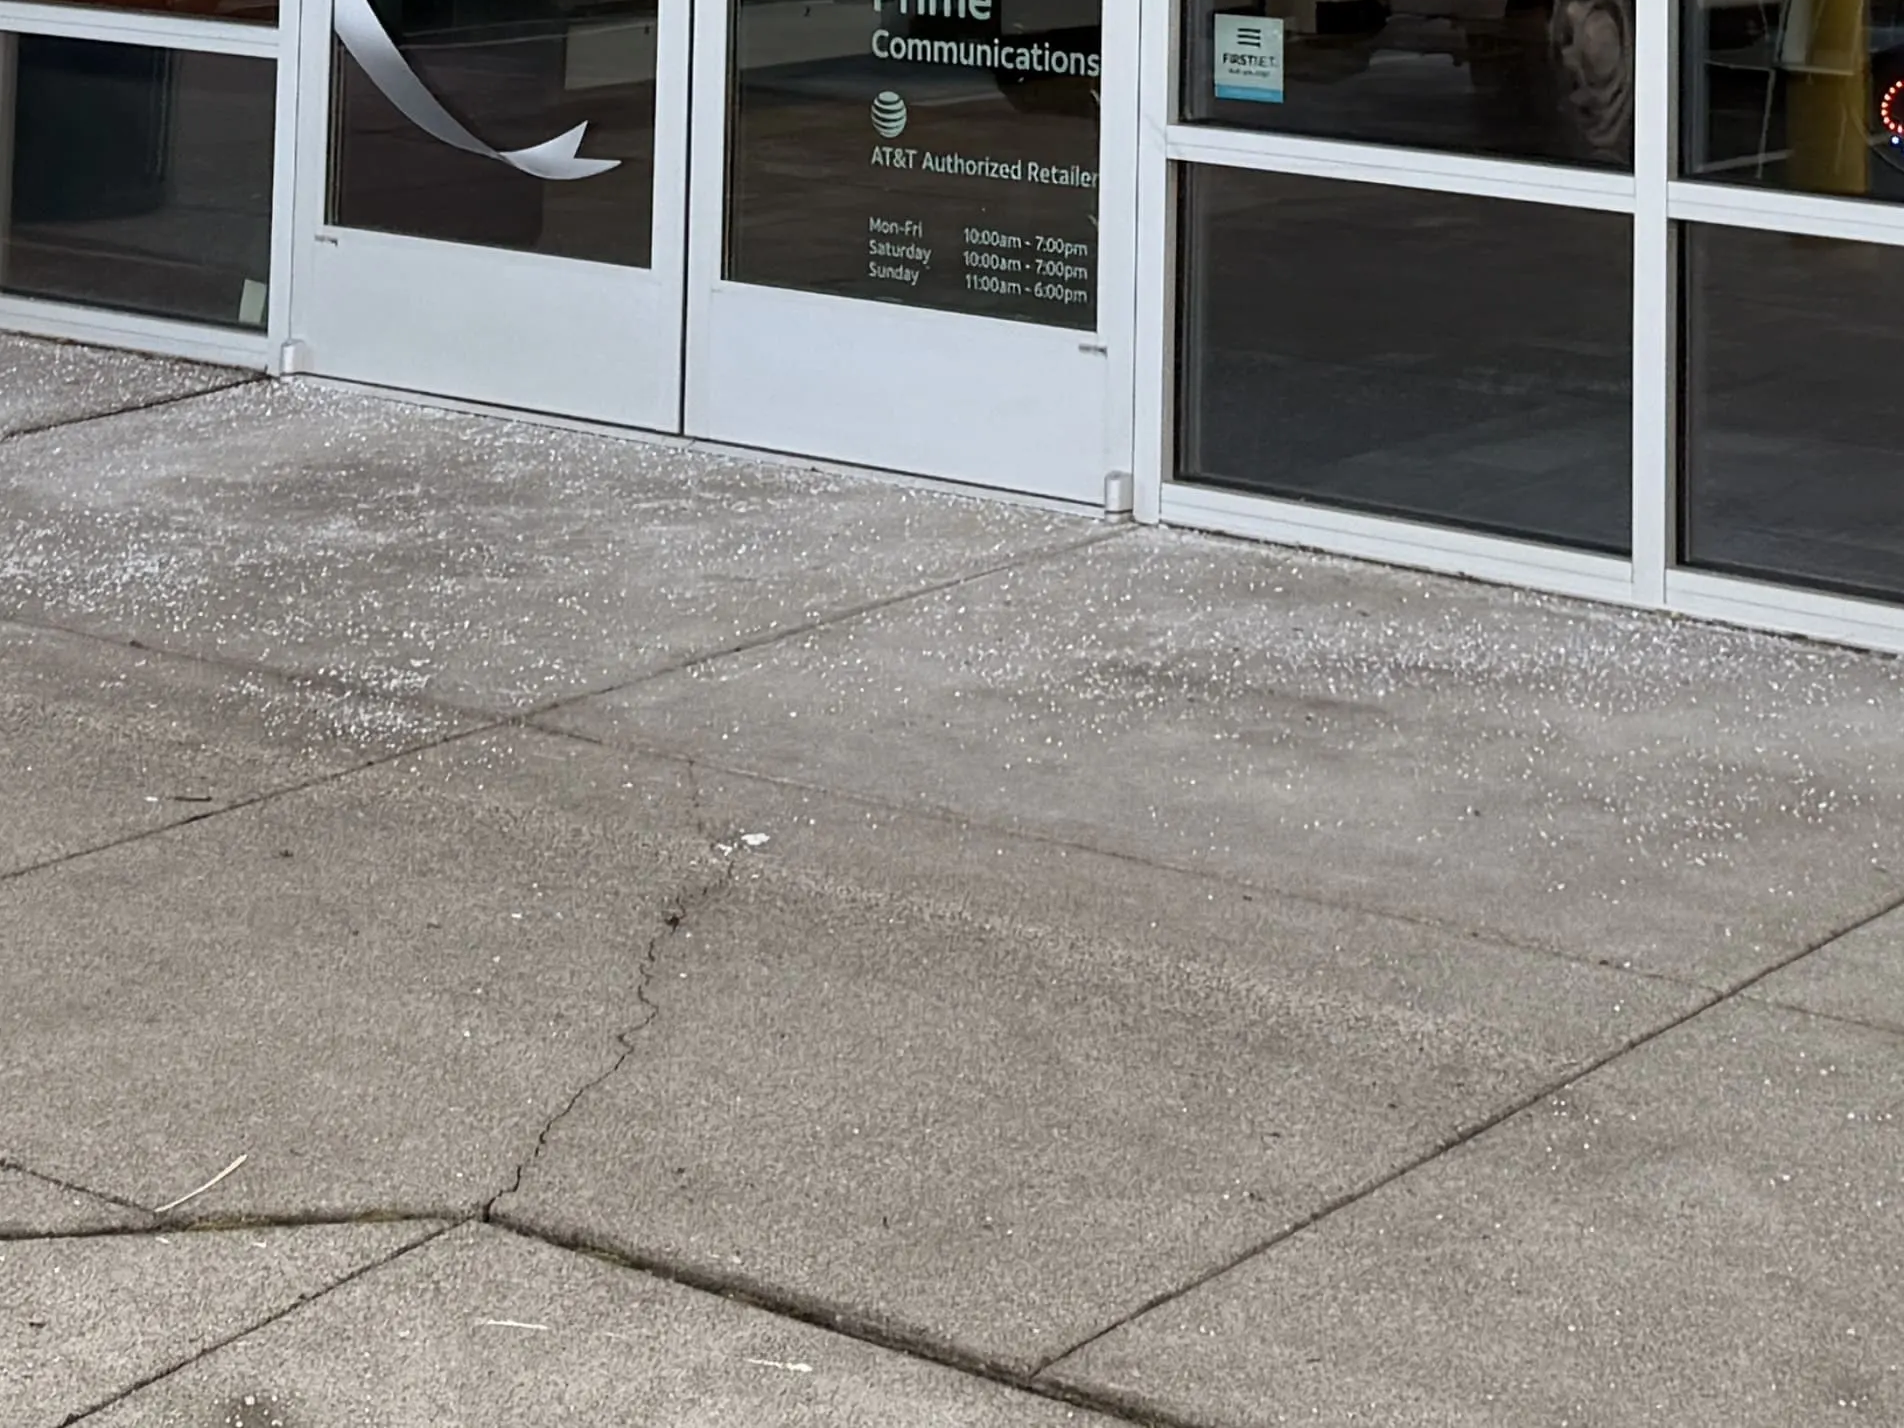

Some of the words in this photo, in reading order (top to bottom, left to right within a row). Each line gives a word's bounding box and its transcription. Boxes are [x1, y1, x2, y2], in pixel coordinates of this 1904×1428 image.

[871, 28, 1101, 78] Communications
[871, 146, 918, 169] AT&T
[922, 151, 1022, 181] Authorized
[1027, 162, 1100, 188] Retailer
[869, 217, 923, 238] Mon-Fri
[964, 228, 1022, 249] 10:00am
[1035, 236, 1088, 258] 7:00pm
[869, 239, 932, 265] Saturday
[963, 251, 1022, 272] 10:00am
[1035, 259, 1088, 280] 7:00pm
[869, 262, 920, 286] Sunday
[965, 274, 1022, 295] 11:00am
[1034, 282, 1088, 304] 6:00pm
